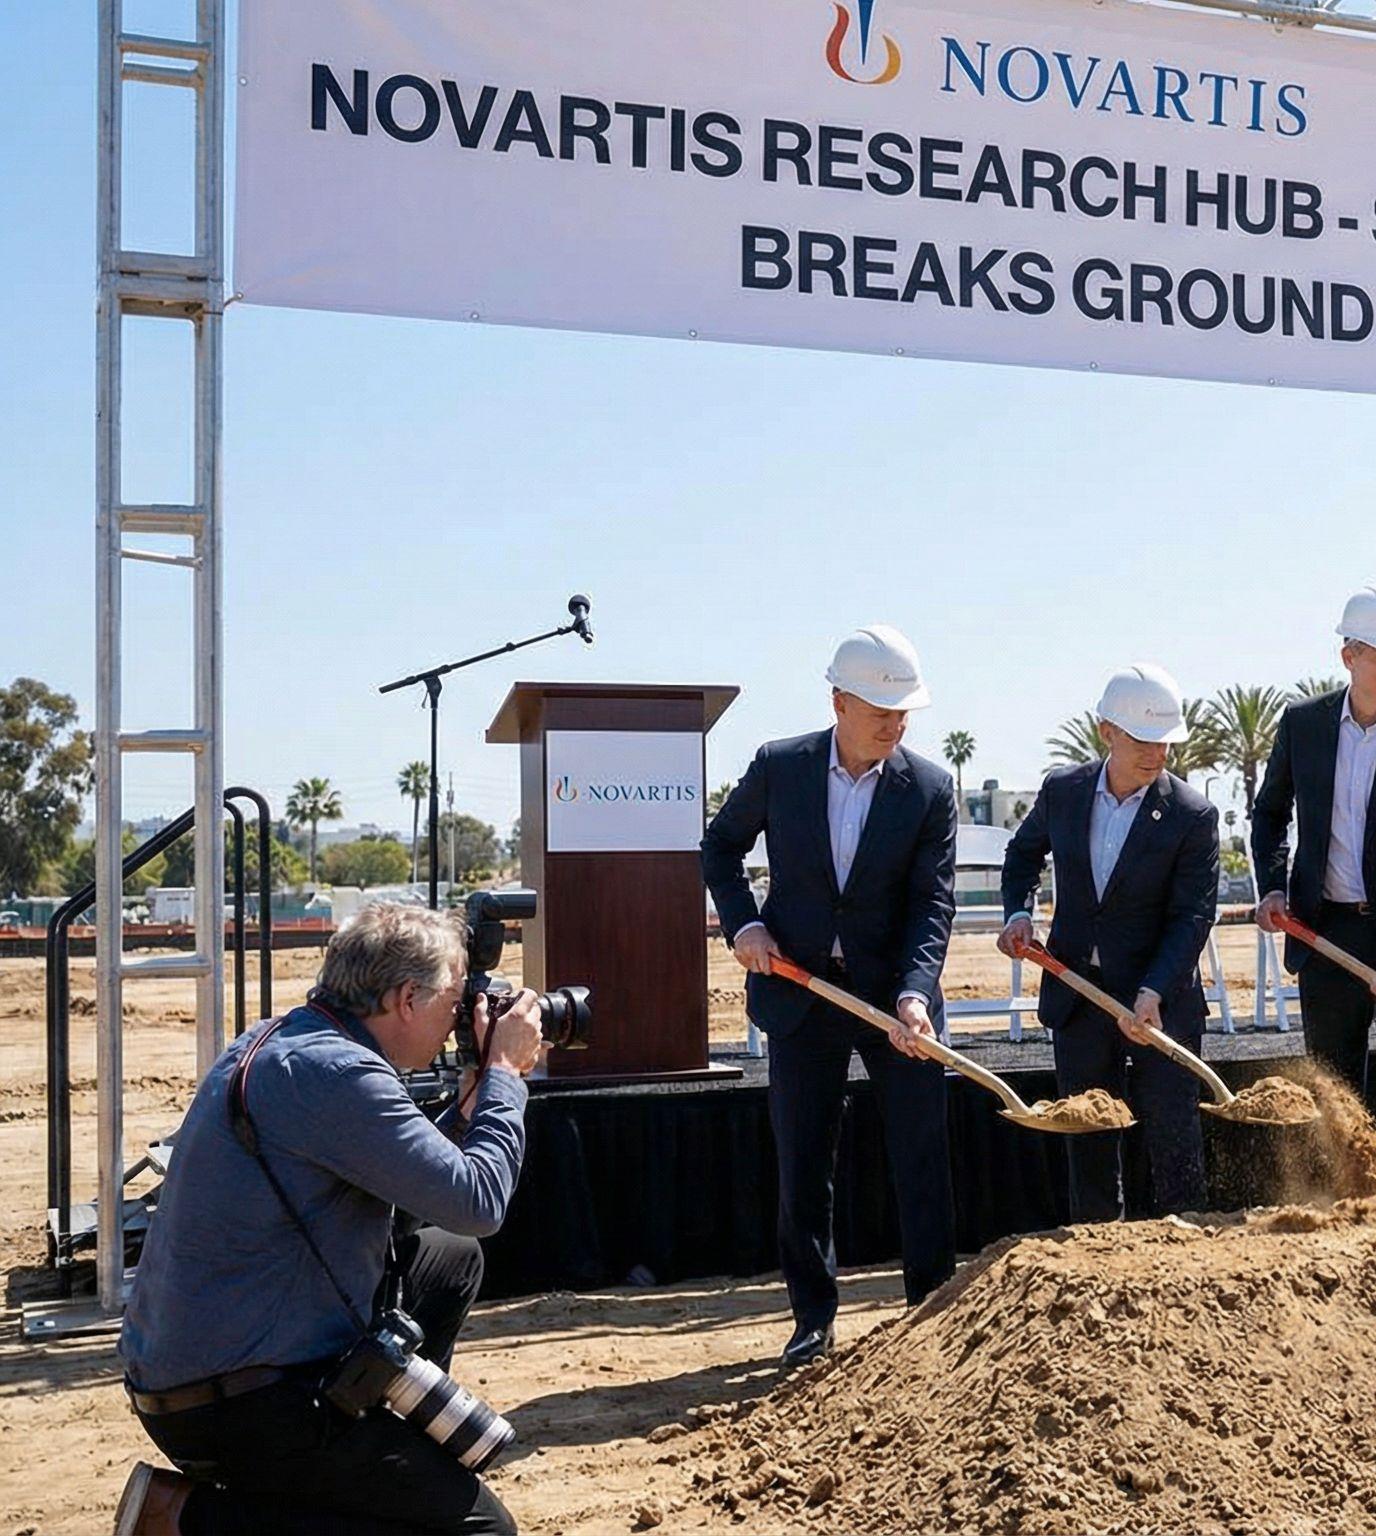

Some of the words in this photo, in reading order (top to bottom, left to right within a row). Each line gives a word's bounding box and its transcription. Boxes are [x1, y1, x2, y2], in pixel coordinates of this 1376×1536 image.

[940, 37, 1308, 137] NOVARTIS
[311, 62, 743, 178] NOVARTIS
[762, 118, 1168, 224] RESEARCH
[1185, 168, 1324, 240] HUB
[1338, 217, 1359, 231] -
[741, 224, 1056, 315] BREAKS
[1072, 258, 1374, 342] GROUND
[588, 785, 696, 802] NOVARTIS
